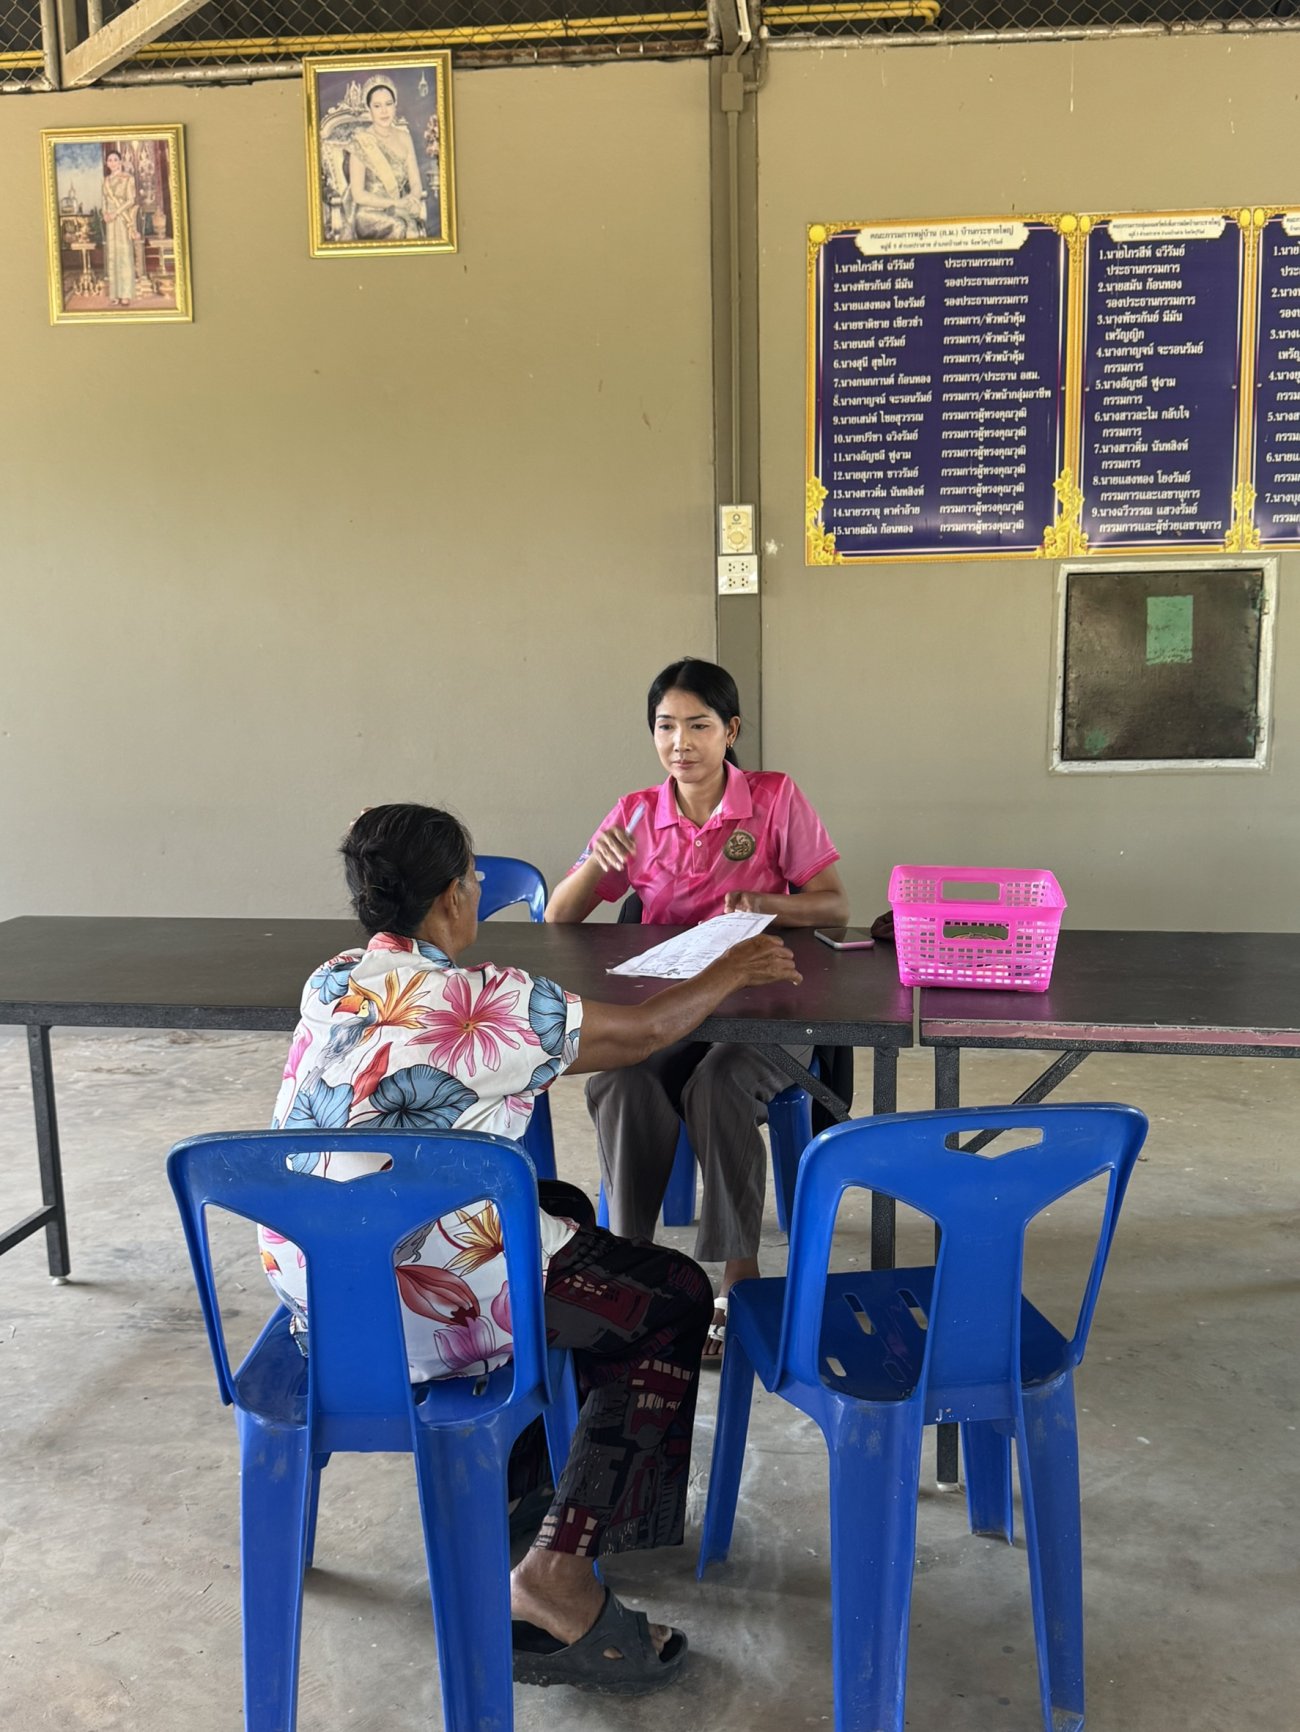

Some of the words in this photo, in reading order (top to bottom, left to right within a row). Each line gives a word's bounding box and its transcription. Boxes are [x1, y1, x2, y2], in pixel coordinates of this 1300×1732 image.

[944, 257, 1014, 268] ประธานกรรมการ
[1106, 264, 1180, 276] ประธานกรรมการ
[944, 276, 1029, 287] รองประธานกรรมการ
[834, 300, 890, 312] 3.นายแสงทอง
[944, 295, 1028, 306] รองประธานกรรมการ
[1106, 296, 1196, 308] รองประธานกรรมการ
[1105, 328, 1144, 342] เหรัญญิก
[1104, 362, 1144, 373] กรรมการ
[943, 371, 1017, 384] กรรมการ/ประธาน
[1020, 371, 1040, 380] อสม.
[1095, 376, 1148, 391] 5.นางอัญชลี
[942, 387, 1051, 402] กรรมการ/หัวหน้ากลุ่มอาชีพ
[1103, 395, 1143, 406] กรรมการ
[942, 407, 1027, 423] กรรมการผู้ทรงคุณวุฒิ
[834, 431, 882, 444] 10.นายปรีชา
[942, 426, 1027, 441] กรรมการผู้ทรงคุณวุฒิ
[1102, 427, 1142, 438] กรรมการ
[834, 450, 885, 463] 11.นางอัญชลี
[941, 445, 1026, 460] กรรมการผู้ทรงคุณวุฒิ
[1102, 459, 1141, 469] กรรมการ
[834, 470, 883, 483] 12.นายสุภาพ
[941, 463, 1026, 479] กรรมการผู้ทรงคุณวุฒิ
[1092, 475, 1154, 486] 8.นายแสงทอง
[940, 482, 1025, 498] กรรมการผู้ทรงคุณวุฒิ
[1101, 489, 1200, 502] กรรมการและเลขานุการ
[940, 500, 1024, 516] กรรมการผู้ทรงคุณวุฒิ
[940, 519, 1024, 534] กรรมการผู้ทรงคุณวุฒิ
[1100, 520, 1222, 535] กรรมการและผู้ช่วยเลขานุการ
